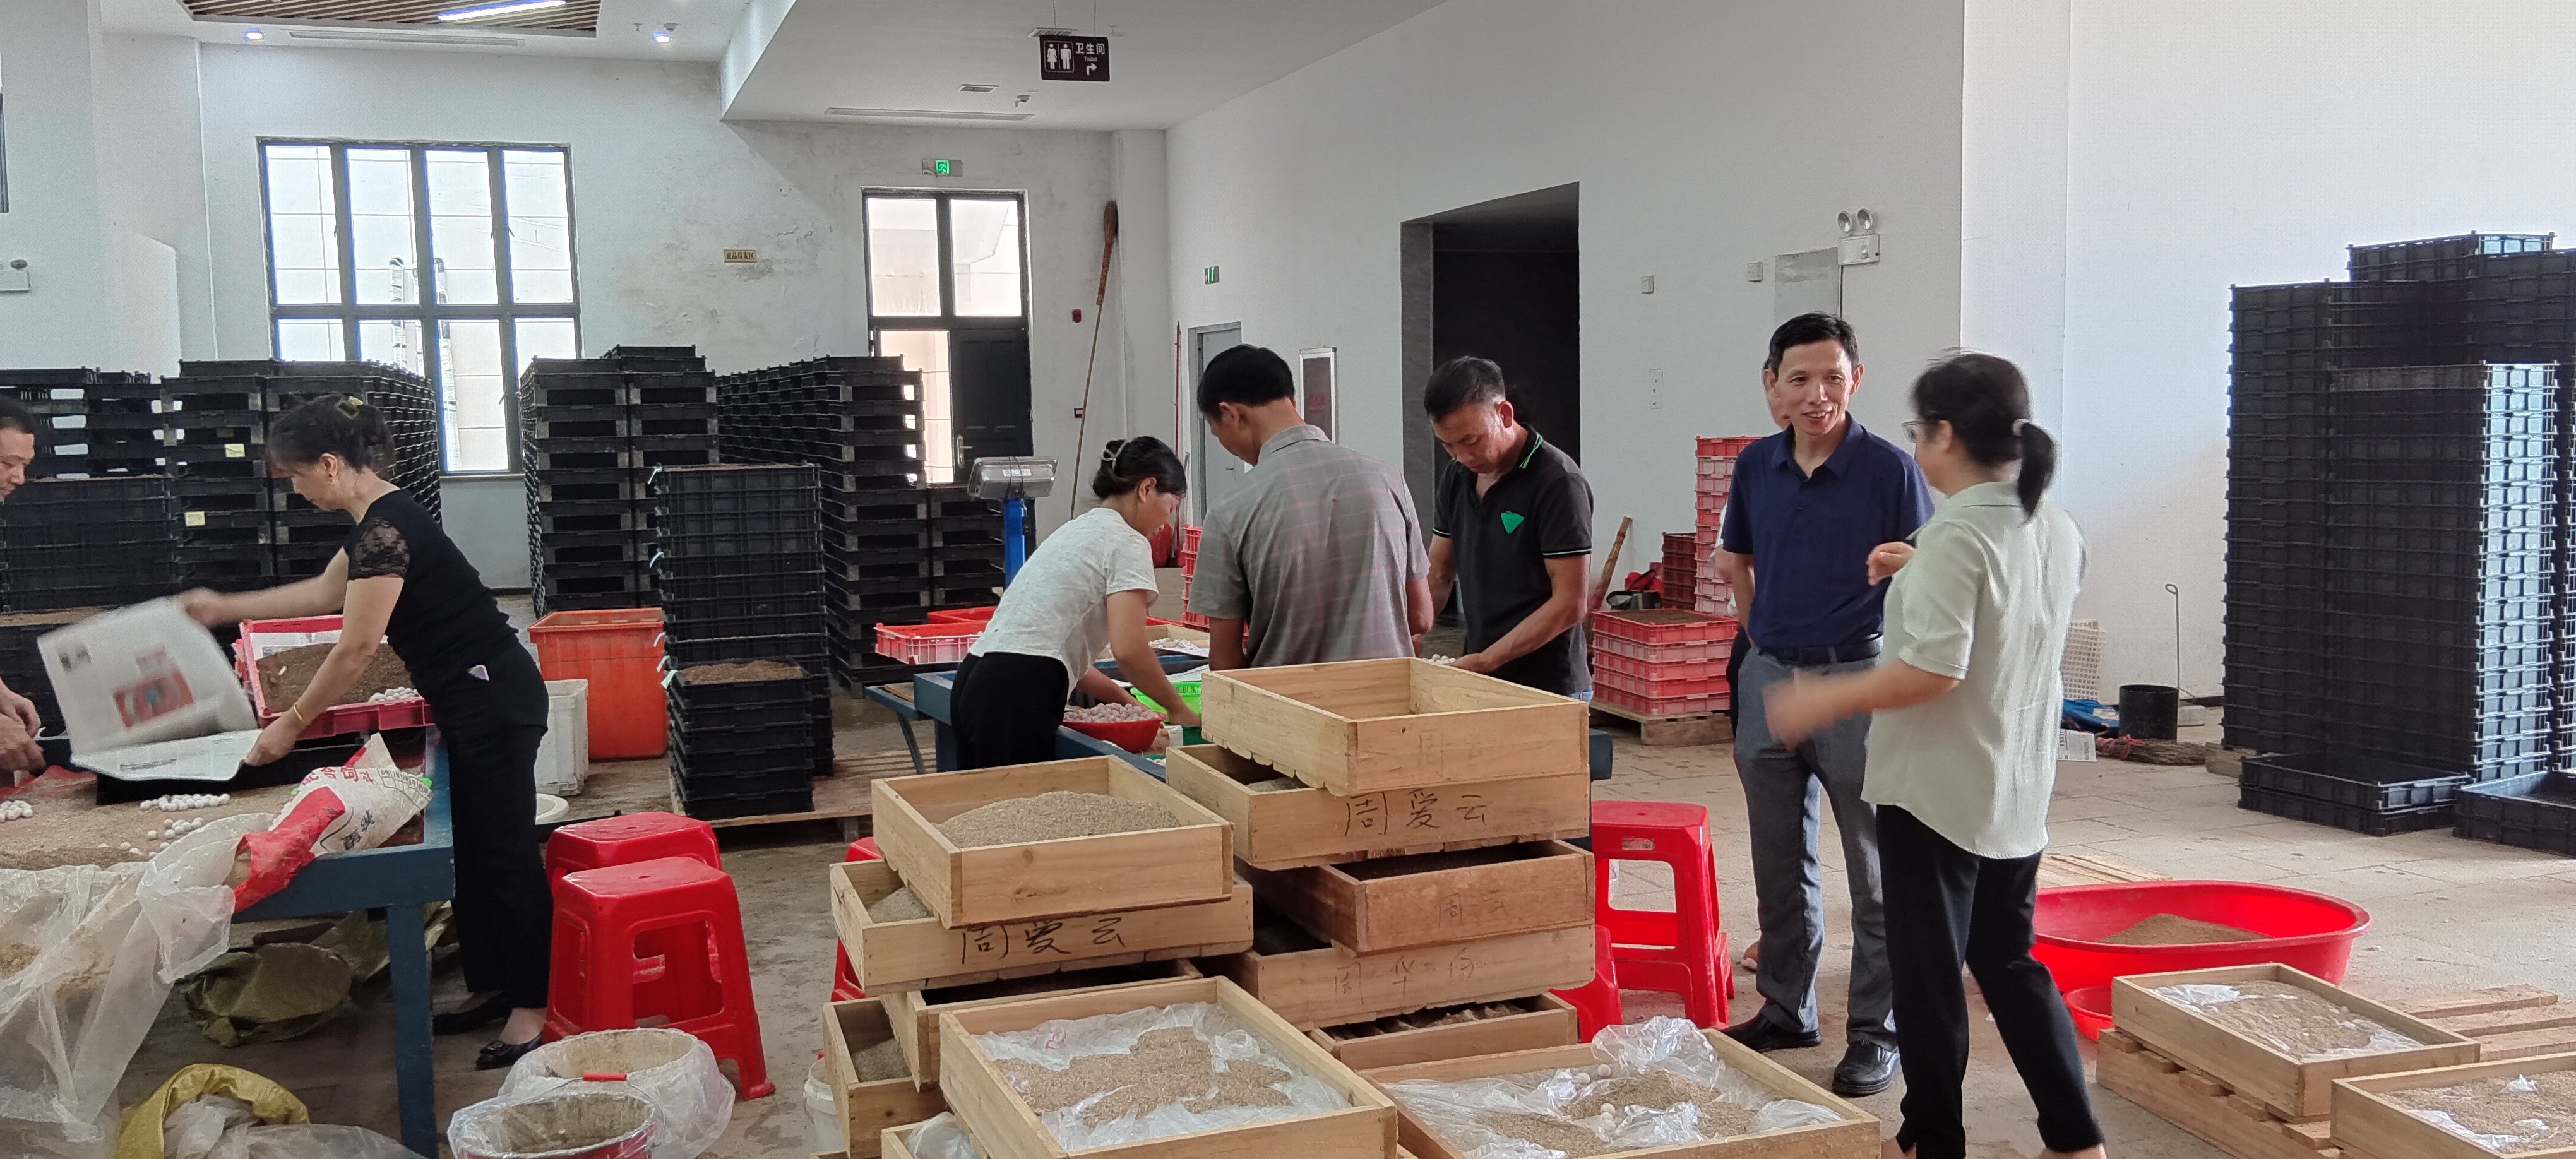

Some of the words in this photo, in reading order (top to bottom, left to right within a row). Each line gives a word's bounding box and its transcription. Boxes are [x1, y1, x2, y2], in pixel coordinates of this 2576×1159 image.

[1075, 42, 1105, 55] 卫生间
[1344, 789, 1487, 836] 周爱云
[962, 917, 1126, 965] 周爱云
